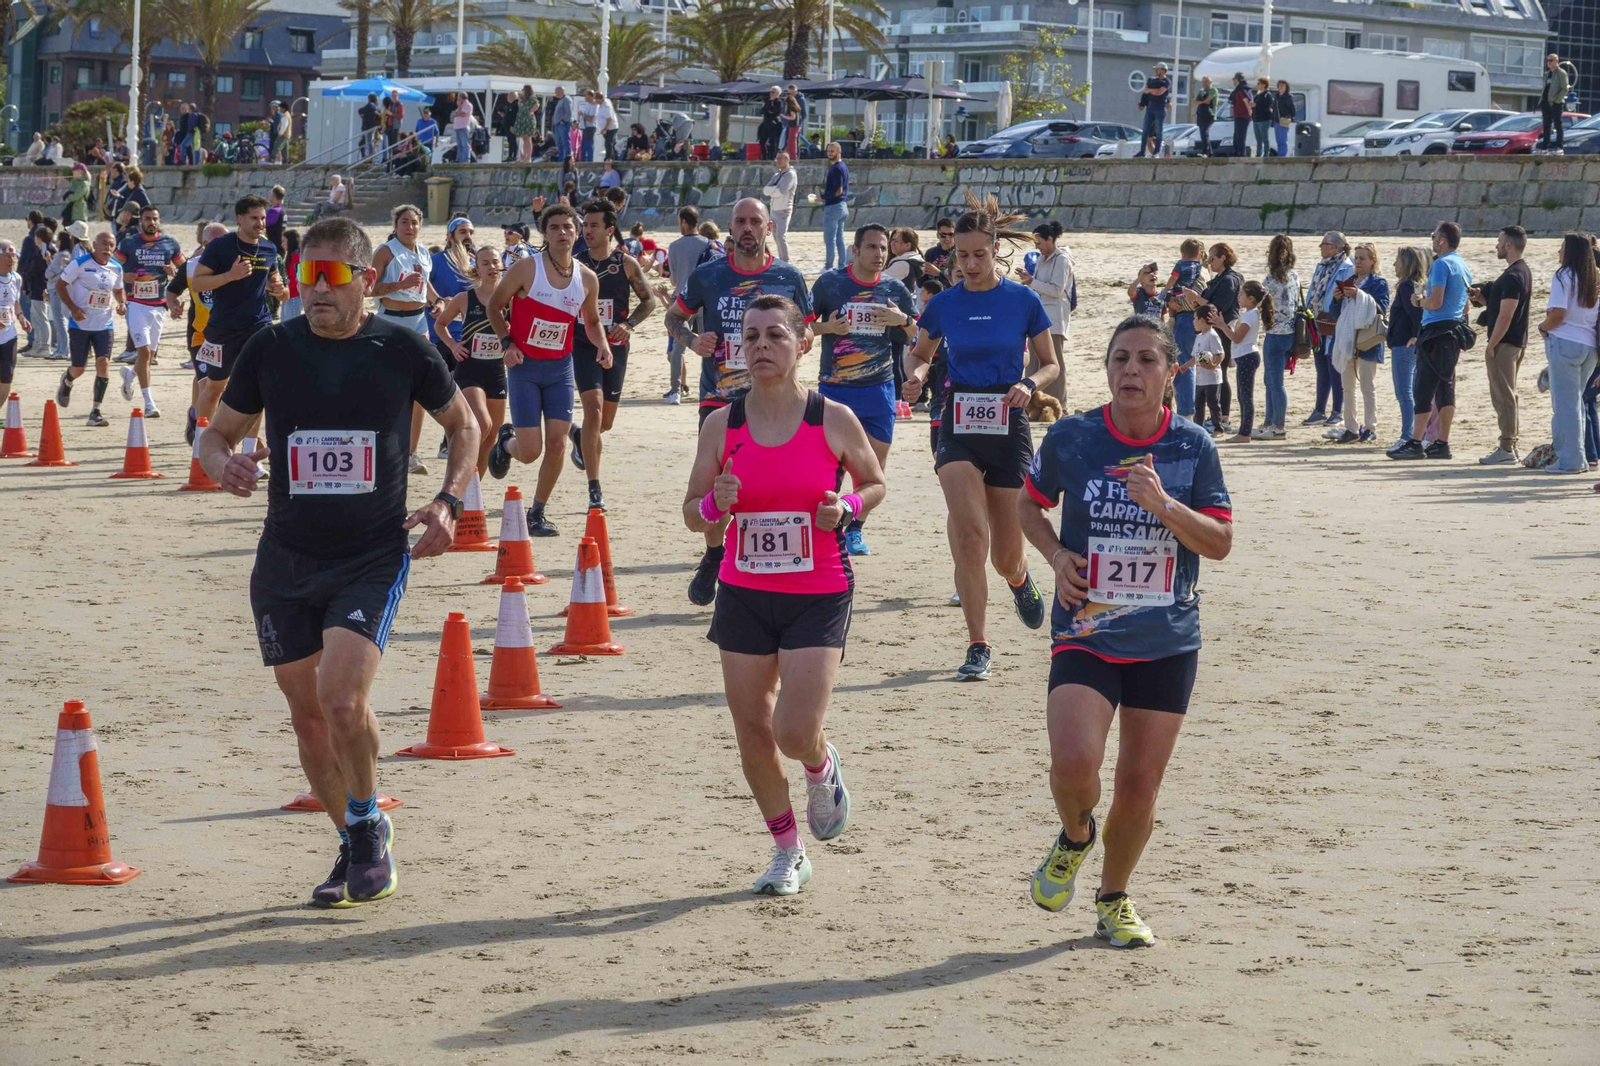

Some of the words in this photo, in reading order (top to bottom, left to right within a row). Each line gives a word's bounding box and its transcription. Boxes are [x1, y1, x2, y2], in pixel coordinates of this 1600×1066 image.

[721, 309, 744, 320] CAR
[856, 312, 872, 323] 38
[538, 329, 559, 340] 679
[201, 346, 215, 358] 624
[480, 341, 499, 351] 550
[733, 344, 743, 356] 7
[965, 406, 996, 420] 486
[308, 452, 353, 472] 103
[1090, 521, 1121, 533] PRAIA
[751, 532, 788, 552] 181
[1108, 561, 1157, 583] 217
